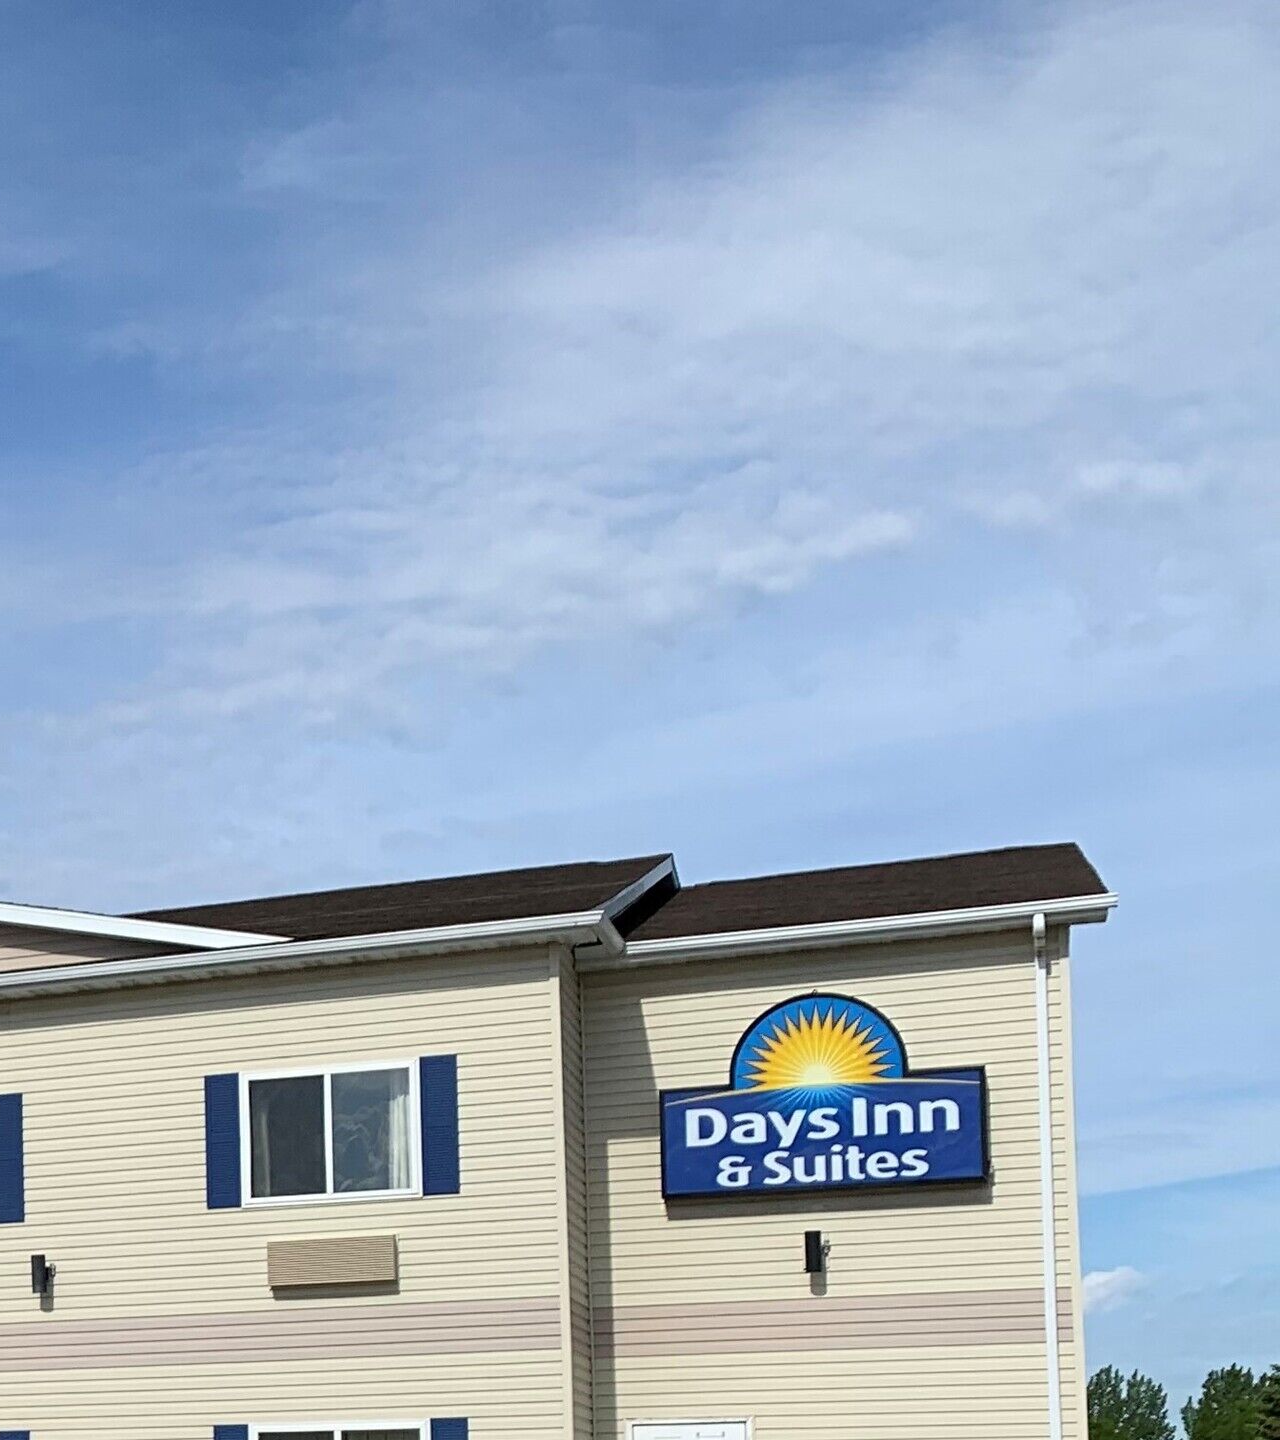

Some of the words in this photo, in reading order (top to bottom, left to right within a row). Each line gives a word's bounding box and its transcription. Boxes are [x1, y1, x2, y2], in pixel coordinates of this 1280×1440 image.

[685, 1106, 839, 1148] Days
[852, 1097, 960, 1137] Inn
[715, 1155, 752, 1188] &
[762, 1143, 930, 1186] Suites
